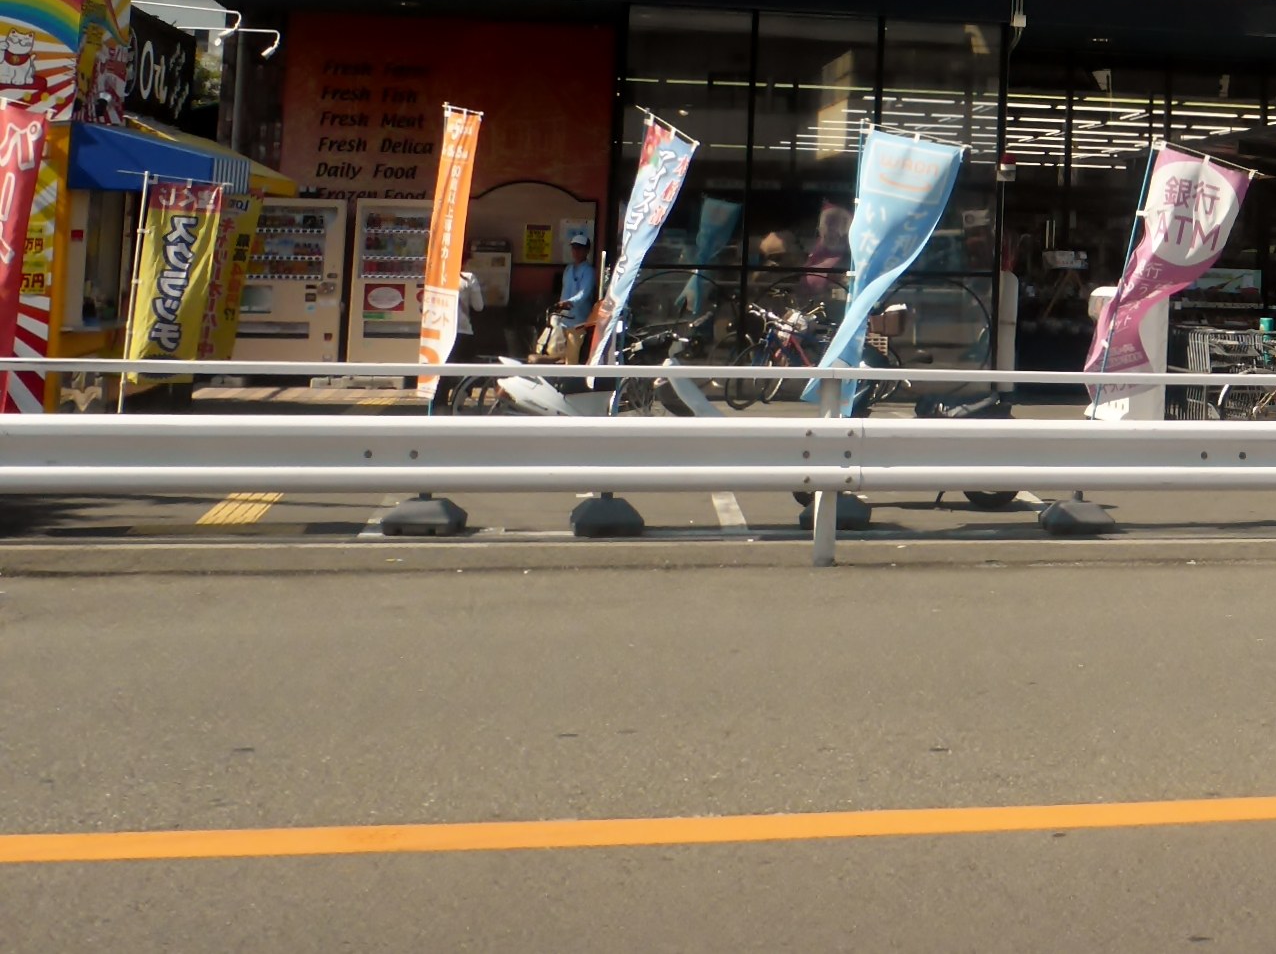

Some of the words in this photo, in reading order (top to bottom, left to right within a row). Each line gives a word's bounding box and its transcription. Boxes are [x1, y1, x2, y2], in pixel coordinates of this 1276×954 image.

[321, 85, 371, 102] Fresh
[319, 111, 370, 127] Fresh
[380, 112, 425, 129] Meat
[318, 137, 368, 153] Fresh
[380, 138, 434, 154] Delica
[316, 162, 363, 180] Daily
[373, 163, 418, 180] Food
[1163, 175, 1220, 215] 銀行
[1154, 213, 1221, 252] ATM
